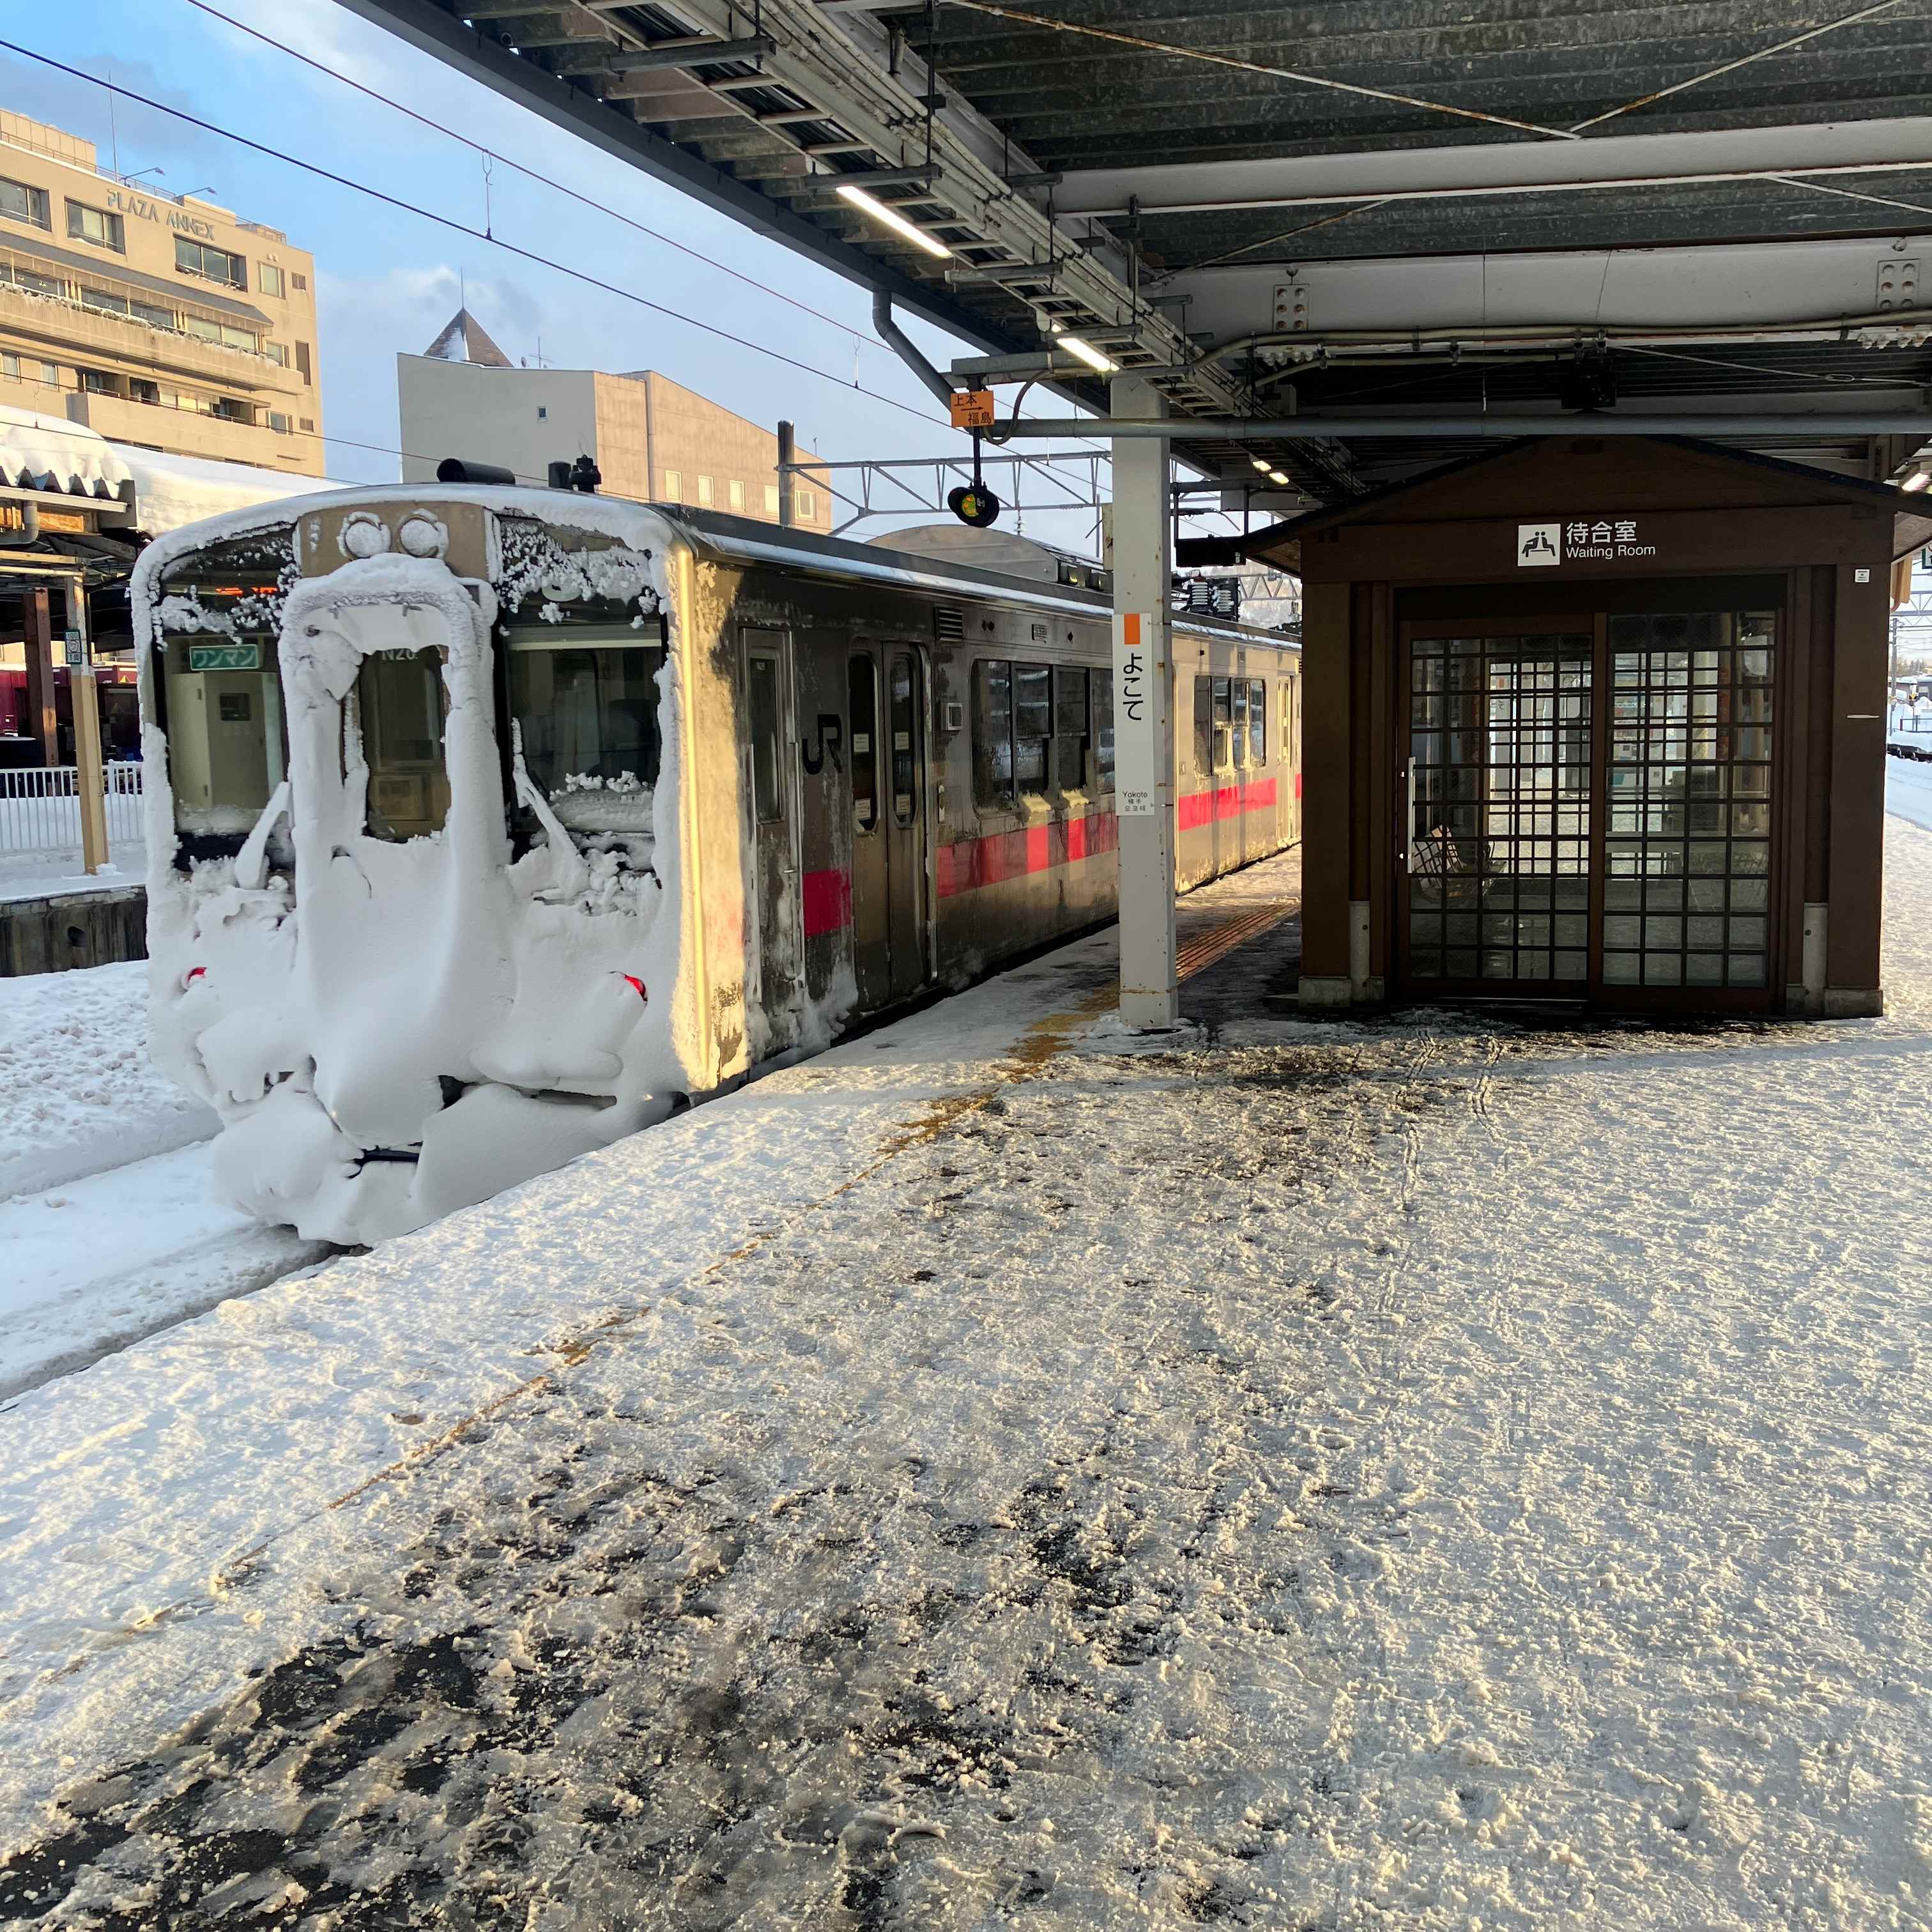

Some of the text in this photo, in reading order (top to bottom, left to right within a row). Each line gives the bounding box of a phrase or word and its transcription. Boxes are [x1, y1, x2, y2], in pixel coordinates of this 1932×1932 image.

[107, 188, 215, 241] PLAZA ANNEX
[954, 394, 977, 406] 上本
[967, 411, 992, 425] 福島
[1567, 520, 1637, 544] 待合室
[1566, 544, 1655, 560] Waiting Room
[193, 649, 256, 667] ワンマン
[1123, 652, 1144, 721] よこて
[802, 714, 842, 775] JR
